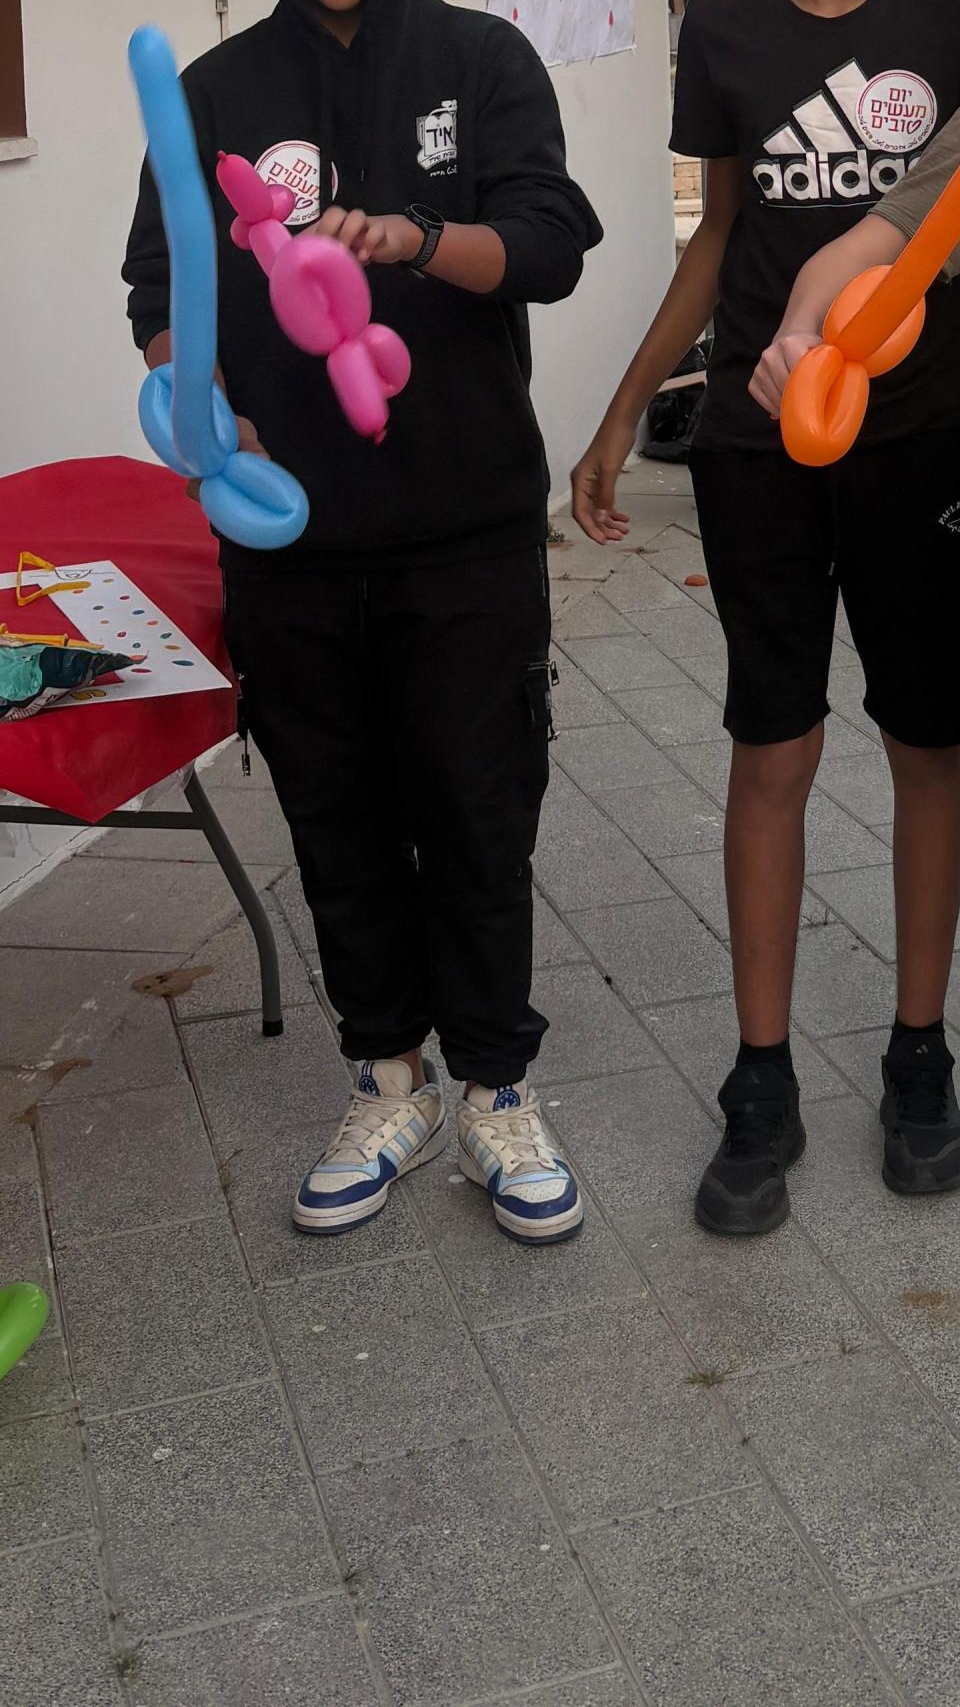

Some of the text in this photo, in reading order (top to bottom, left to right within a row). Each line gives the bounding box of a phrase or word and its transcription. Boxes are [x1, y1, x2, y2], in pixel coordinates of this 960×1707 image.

[890, 87, 912, 102] יום
[871, 99, 927, 119] מעשים
[871, 114, 922, 135] טובים
[292, 158, 318, 177] יום
